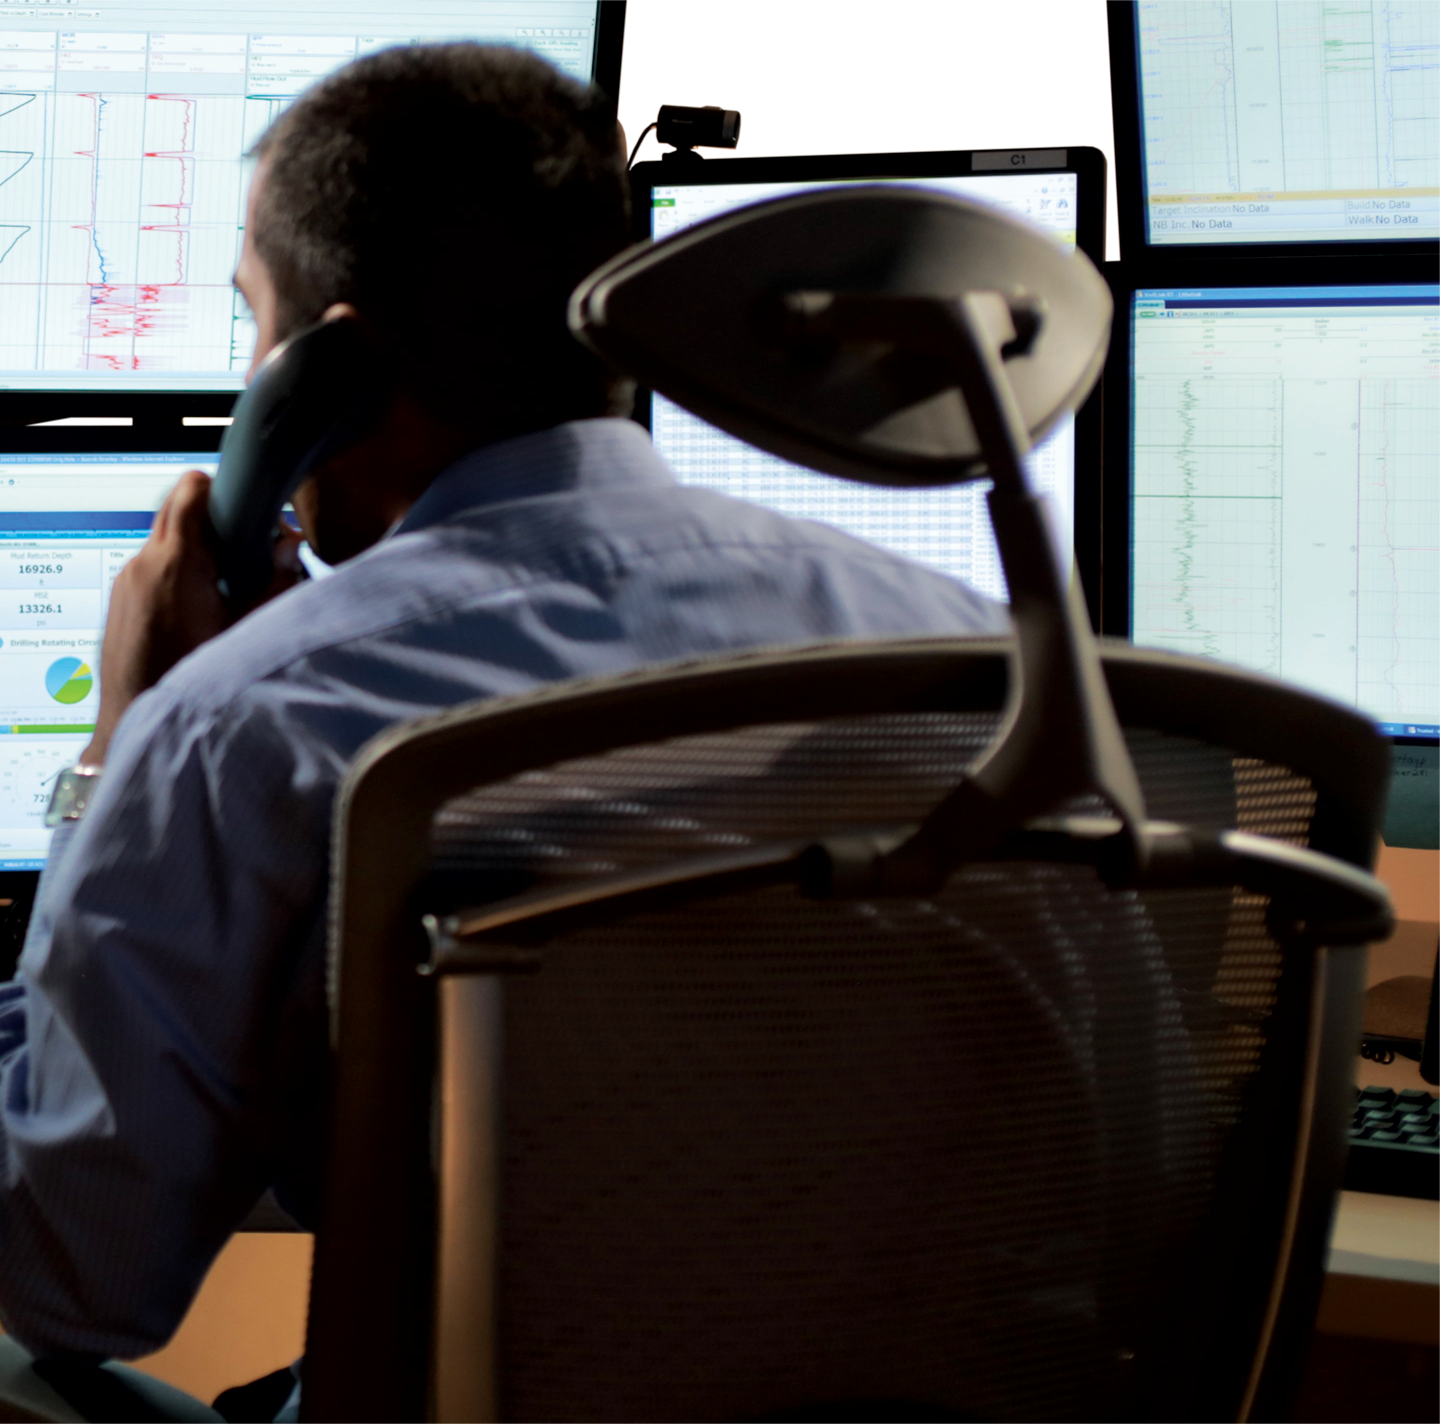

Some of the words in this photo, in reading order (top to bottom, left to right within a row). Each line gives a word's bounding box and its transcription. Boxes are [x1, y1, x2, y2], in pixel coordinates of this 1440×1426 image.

[1010, 154, 1026, 166] C1
[1152, 205, 1181, 216] Target
[1183, 204, 1231, 215] Inclination
[1232, 204, 1245, 214] No
[1247, 204, 1270, 214] Data
[1347, 200, 1371, 210] Build
[1372, 200, 1386, 210] No
[1388, 200, 1411, 210] Data
[1153, 219, 1168, 230] NB
[1170, 219, 1190, 229] Inc.
[1191, 219, 1205, 229] No
[1208, 219, 1233, 229] Data
[1348, 214, 1374, 225] Walk
[1375, 215, 1390, 225] No
[1393, 214, 1419, 225] Data
[10, 552, 25, 560] Mud
[52, 552, 73, 560] Depth
[19, 564, 63, 574] 16926.9
[19, 604, 63, 614] 13326.1
[10, 640, 39, 648] Drilling
[41, 639, 76, 648] Rotating
